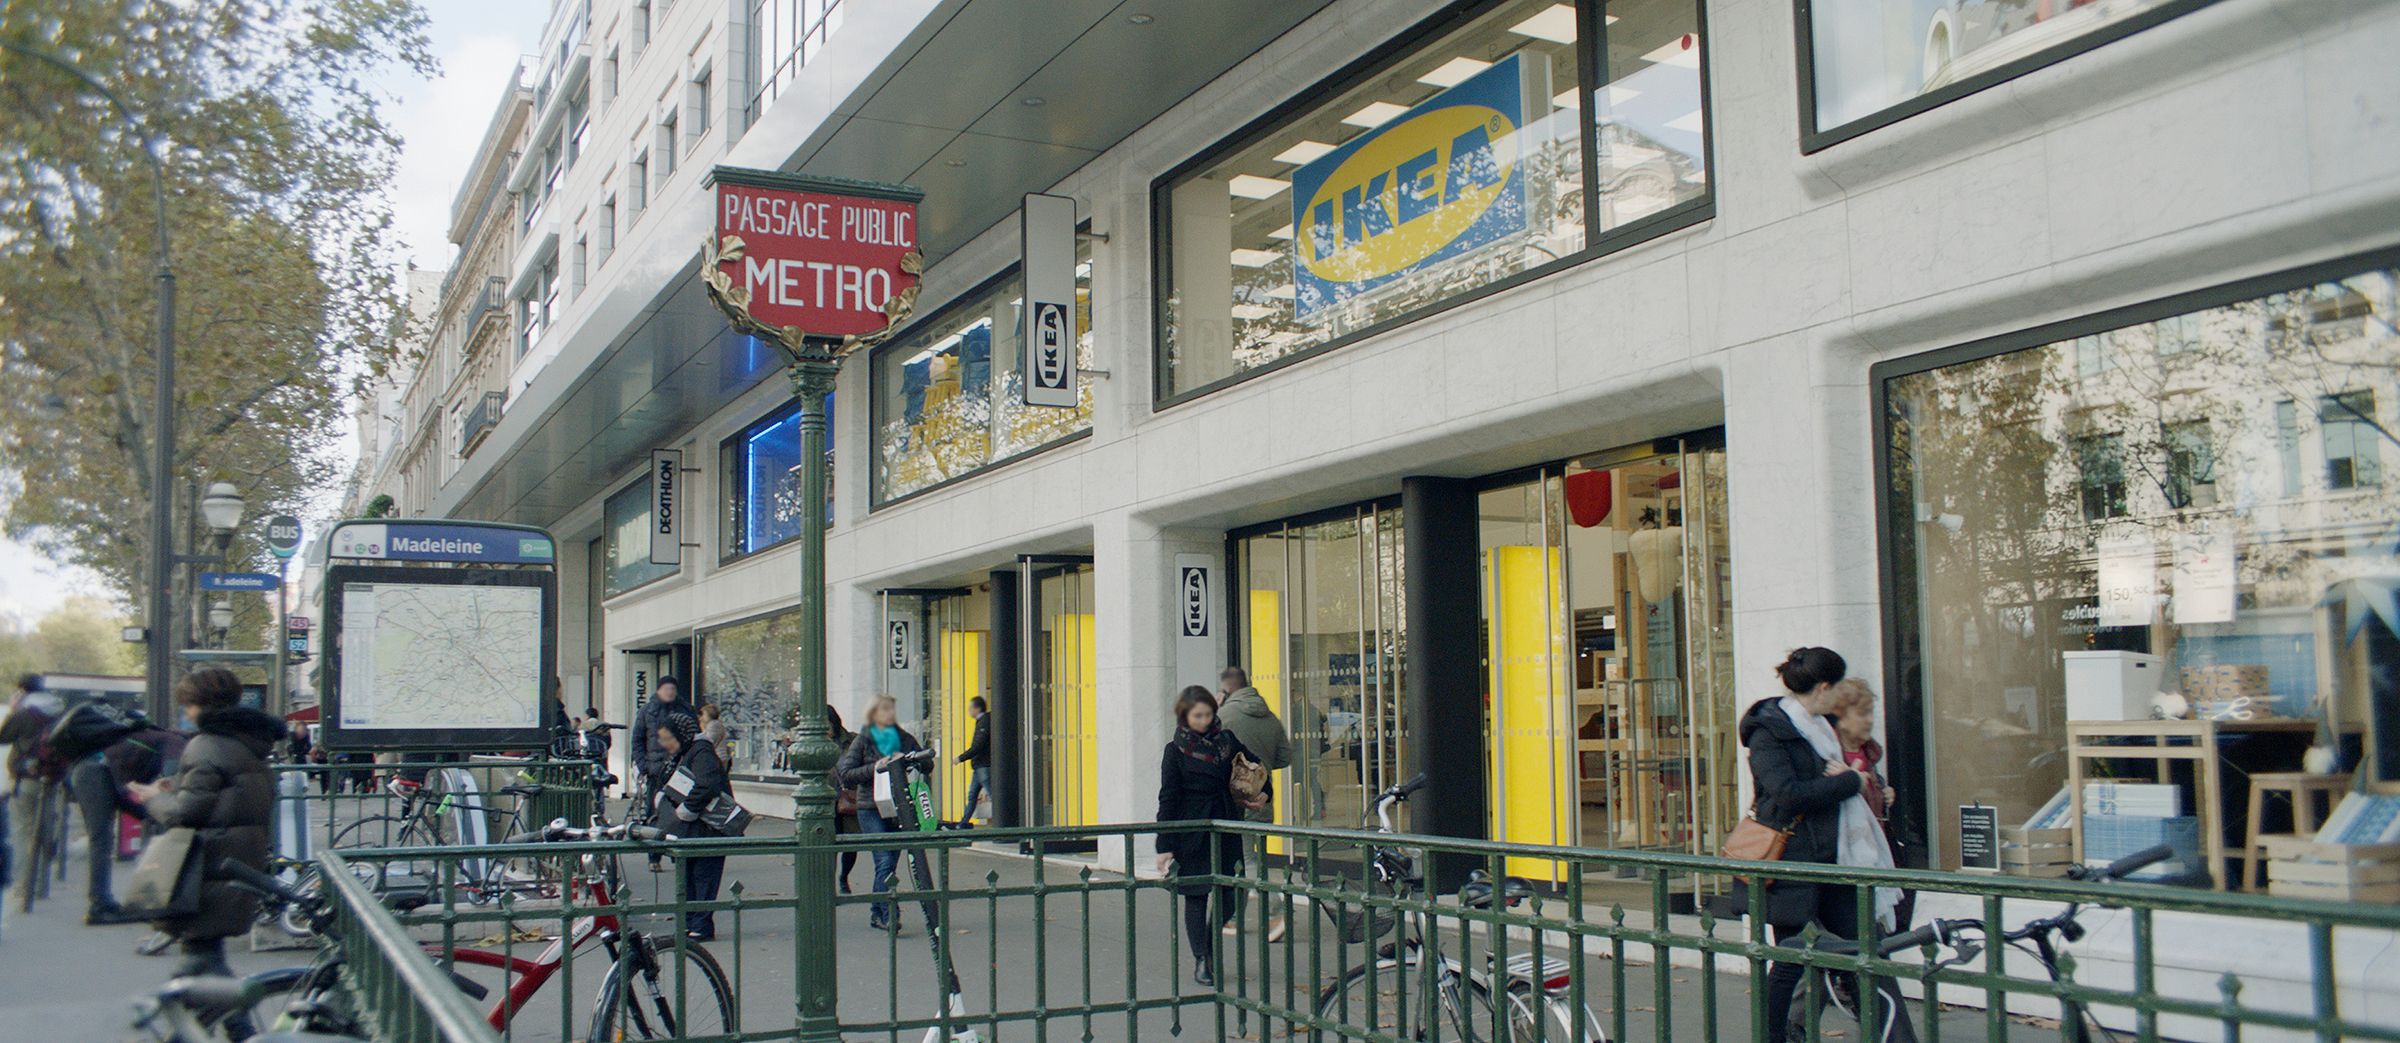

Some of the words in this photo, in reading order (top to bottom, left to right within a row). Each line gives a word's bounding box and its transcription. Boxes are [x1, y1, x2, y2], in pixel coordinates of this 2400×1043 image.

[1313, 123, 1502, 262] IKEA
[724, 193, 832, 240] PASSAGE
[841, 205, 912, 248] PUBLIC
[744, 255, 892, 313] METRO
[1044, 310, 1057, 380] IKEA
[659, 459, 673, 535] DECATHLON
[270, 525, 299, 539] BUS
[392, 536, 484, 555] Madeleine
[292, 619, 306, 629] 45
[1190, 573, 1200, 629] IKEA
[292, 640, 306, 650] 52
[895, 625, 903, 665] IKEA
[636, 670, 647, 709] THLON
